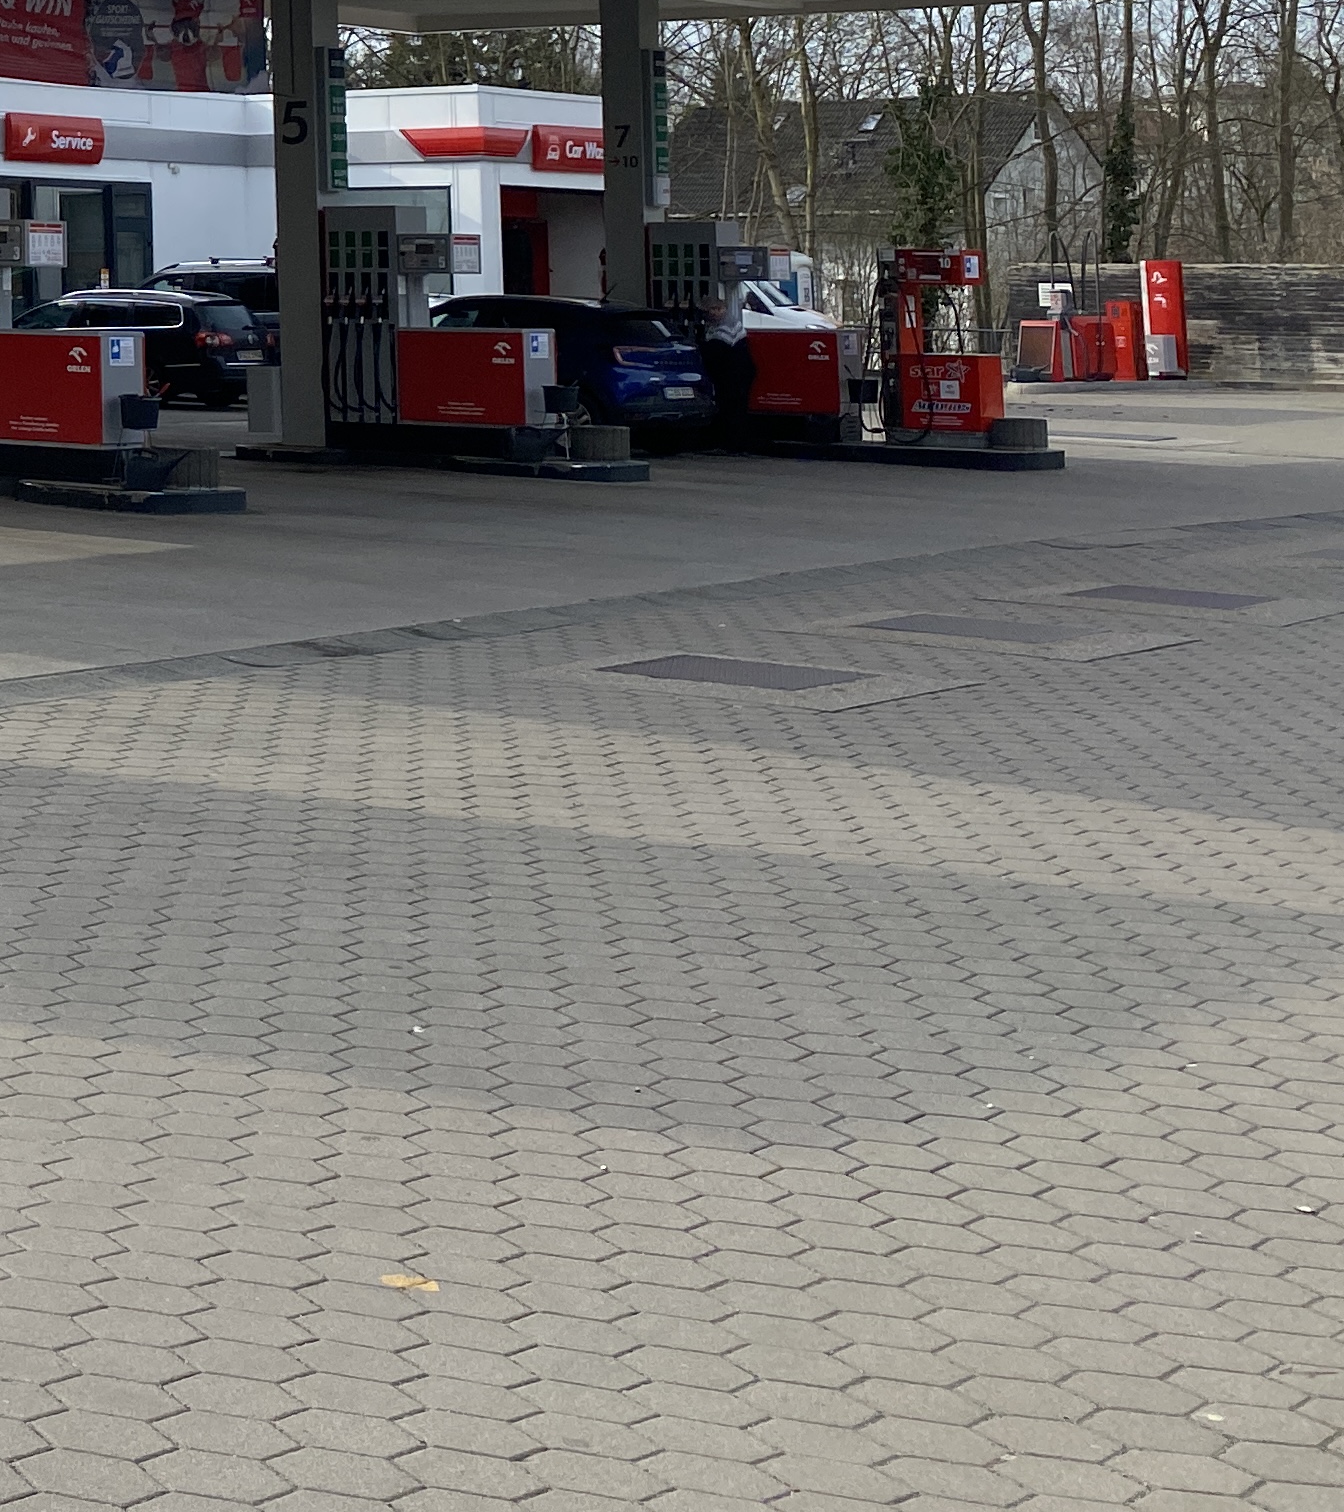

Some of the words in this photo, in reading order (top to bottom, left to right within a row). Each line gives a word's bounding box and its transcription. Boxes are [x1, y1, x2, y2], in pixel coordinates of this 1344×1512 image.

[282, 101, 308, 145] 5
[51, 130, 94, 150] Service
[615, 125, 630, 148] 7
[565, 140, 584, 159] Car
[584, 141, 604, 159] Wa
[622, 156, 639, 168] 10
[939, 256, 951, 269] 10
